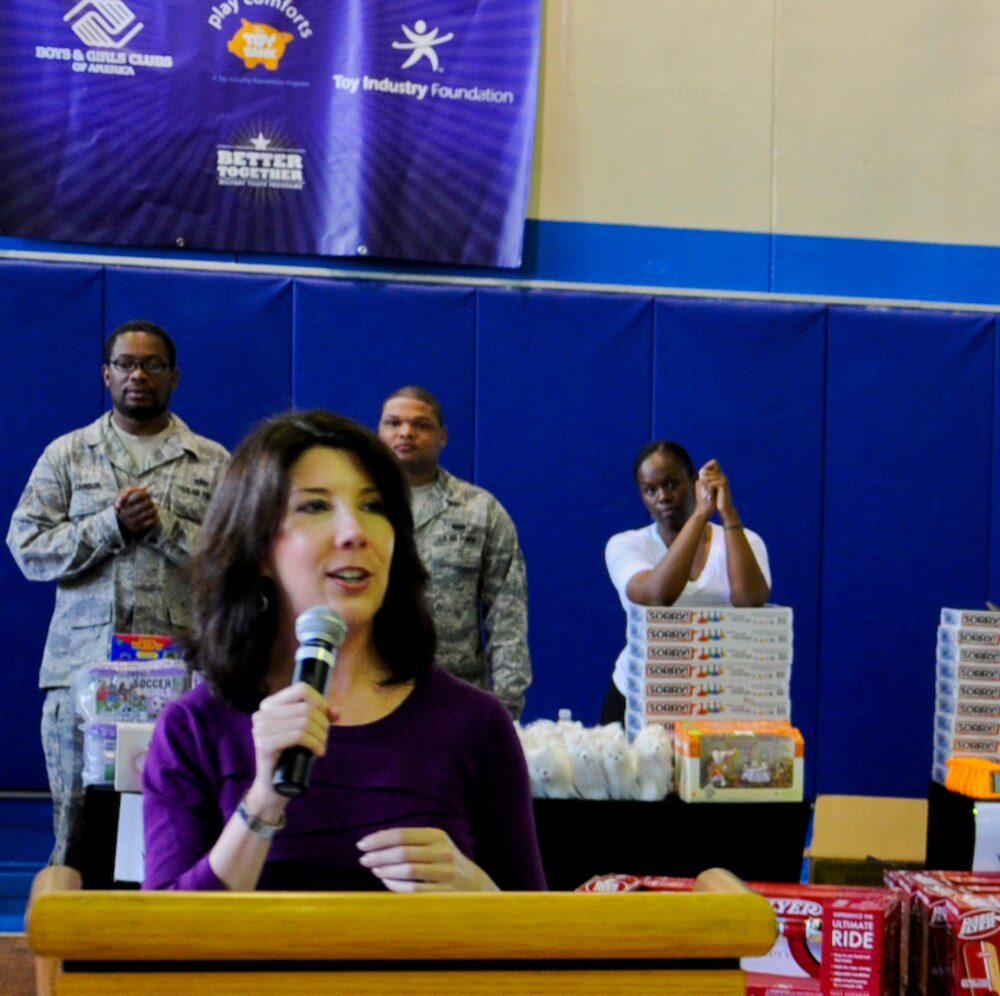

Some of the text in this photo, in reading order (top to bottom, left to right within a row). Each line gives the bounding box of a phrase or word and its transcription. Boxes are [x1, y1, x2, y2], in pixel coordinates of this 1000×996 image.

[208, 0, 239, 30] play
[35, 46, 173, 68] BOYS & GIRLS CLUBS
[72, 62, 135, 76] OF AMERICA
[333, 74, 514, 103] Toy Industry Foundation
[217, 150, 303, 169] BETTER
[217, 165, 303, 181] TOGETHER
[773, 900, 823, 915] YER
[832, 919, 873, 930] ULTIMATE
[831, 929, 873, 949] RIDE
